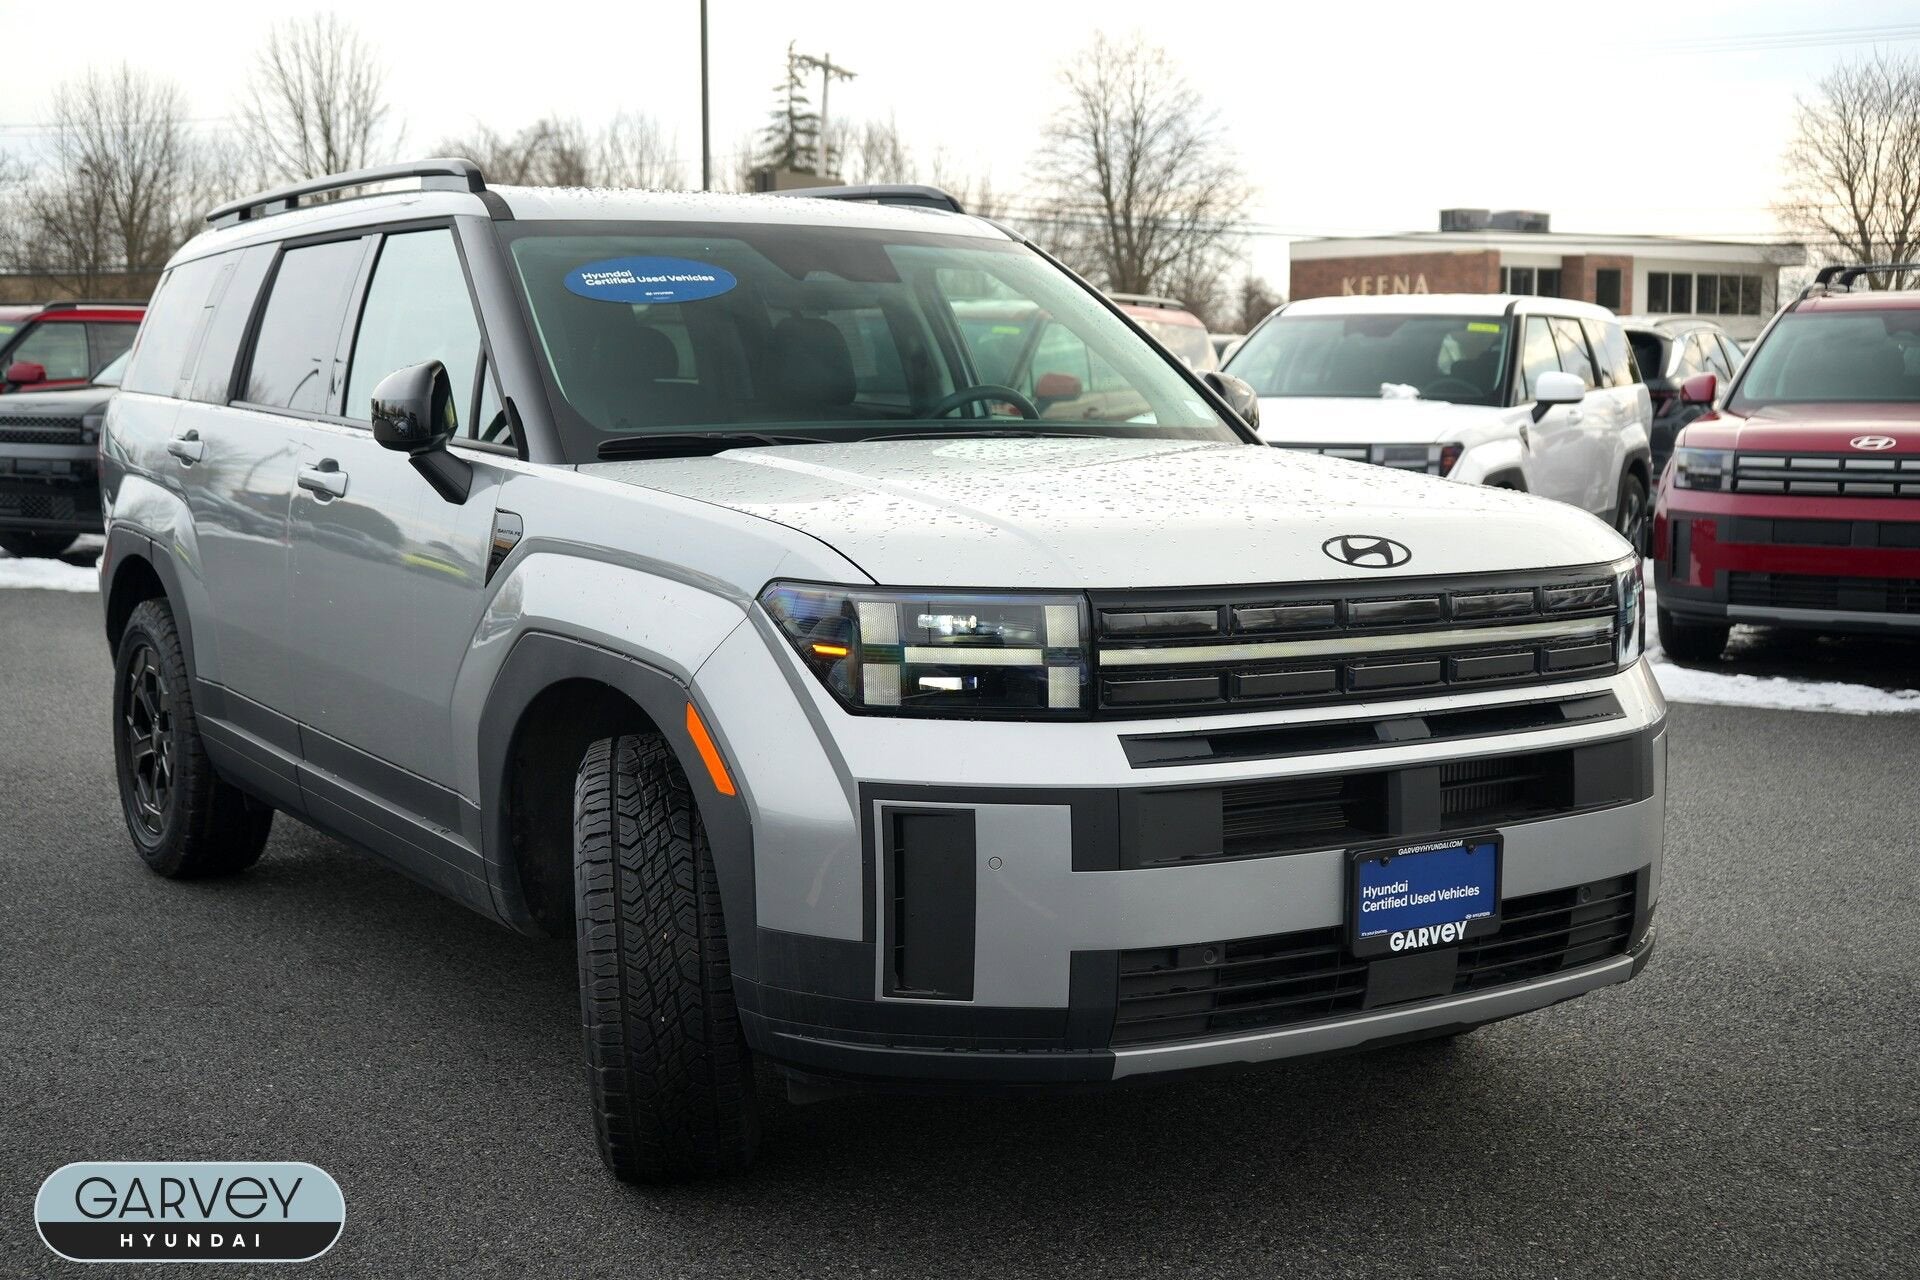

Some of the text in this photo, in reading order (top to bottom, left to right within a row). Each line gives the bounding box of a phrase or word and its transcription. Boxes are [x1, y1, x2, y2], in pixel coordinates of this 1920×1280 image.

[582, 270, 632, 280] Hyundai
[585, 274, 716, 286] Certified Used Vehicles
[1342, 273, 1430, 296] KEENA
[1363, 880, 1408, 898] Hyundai
[1362, 885, 1480, 913] Certified Used Vehicles
